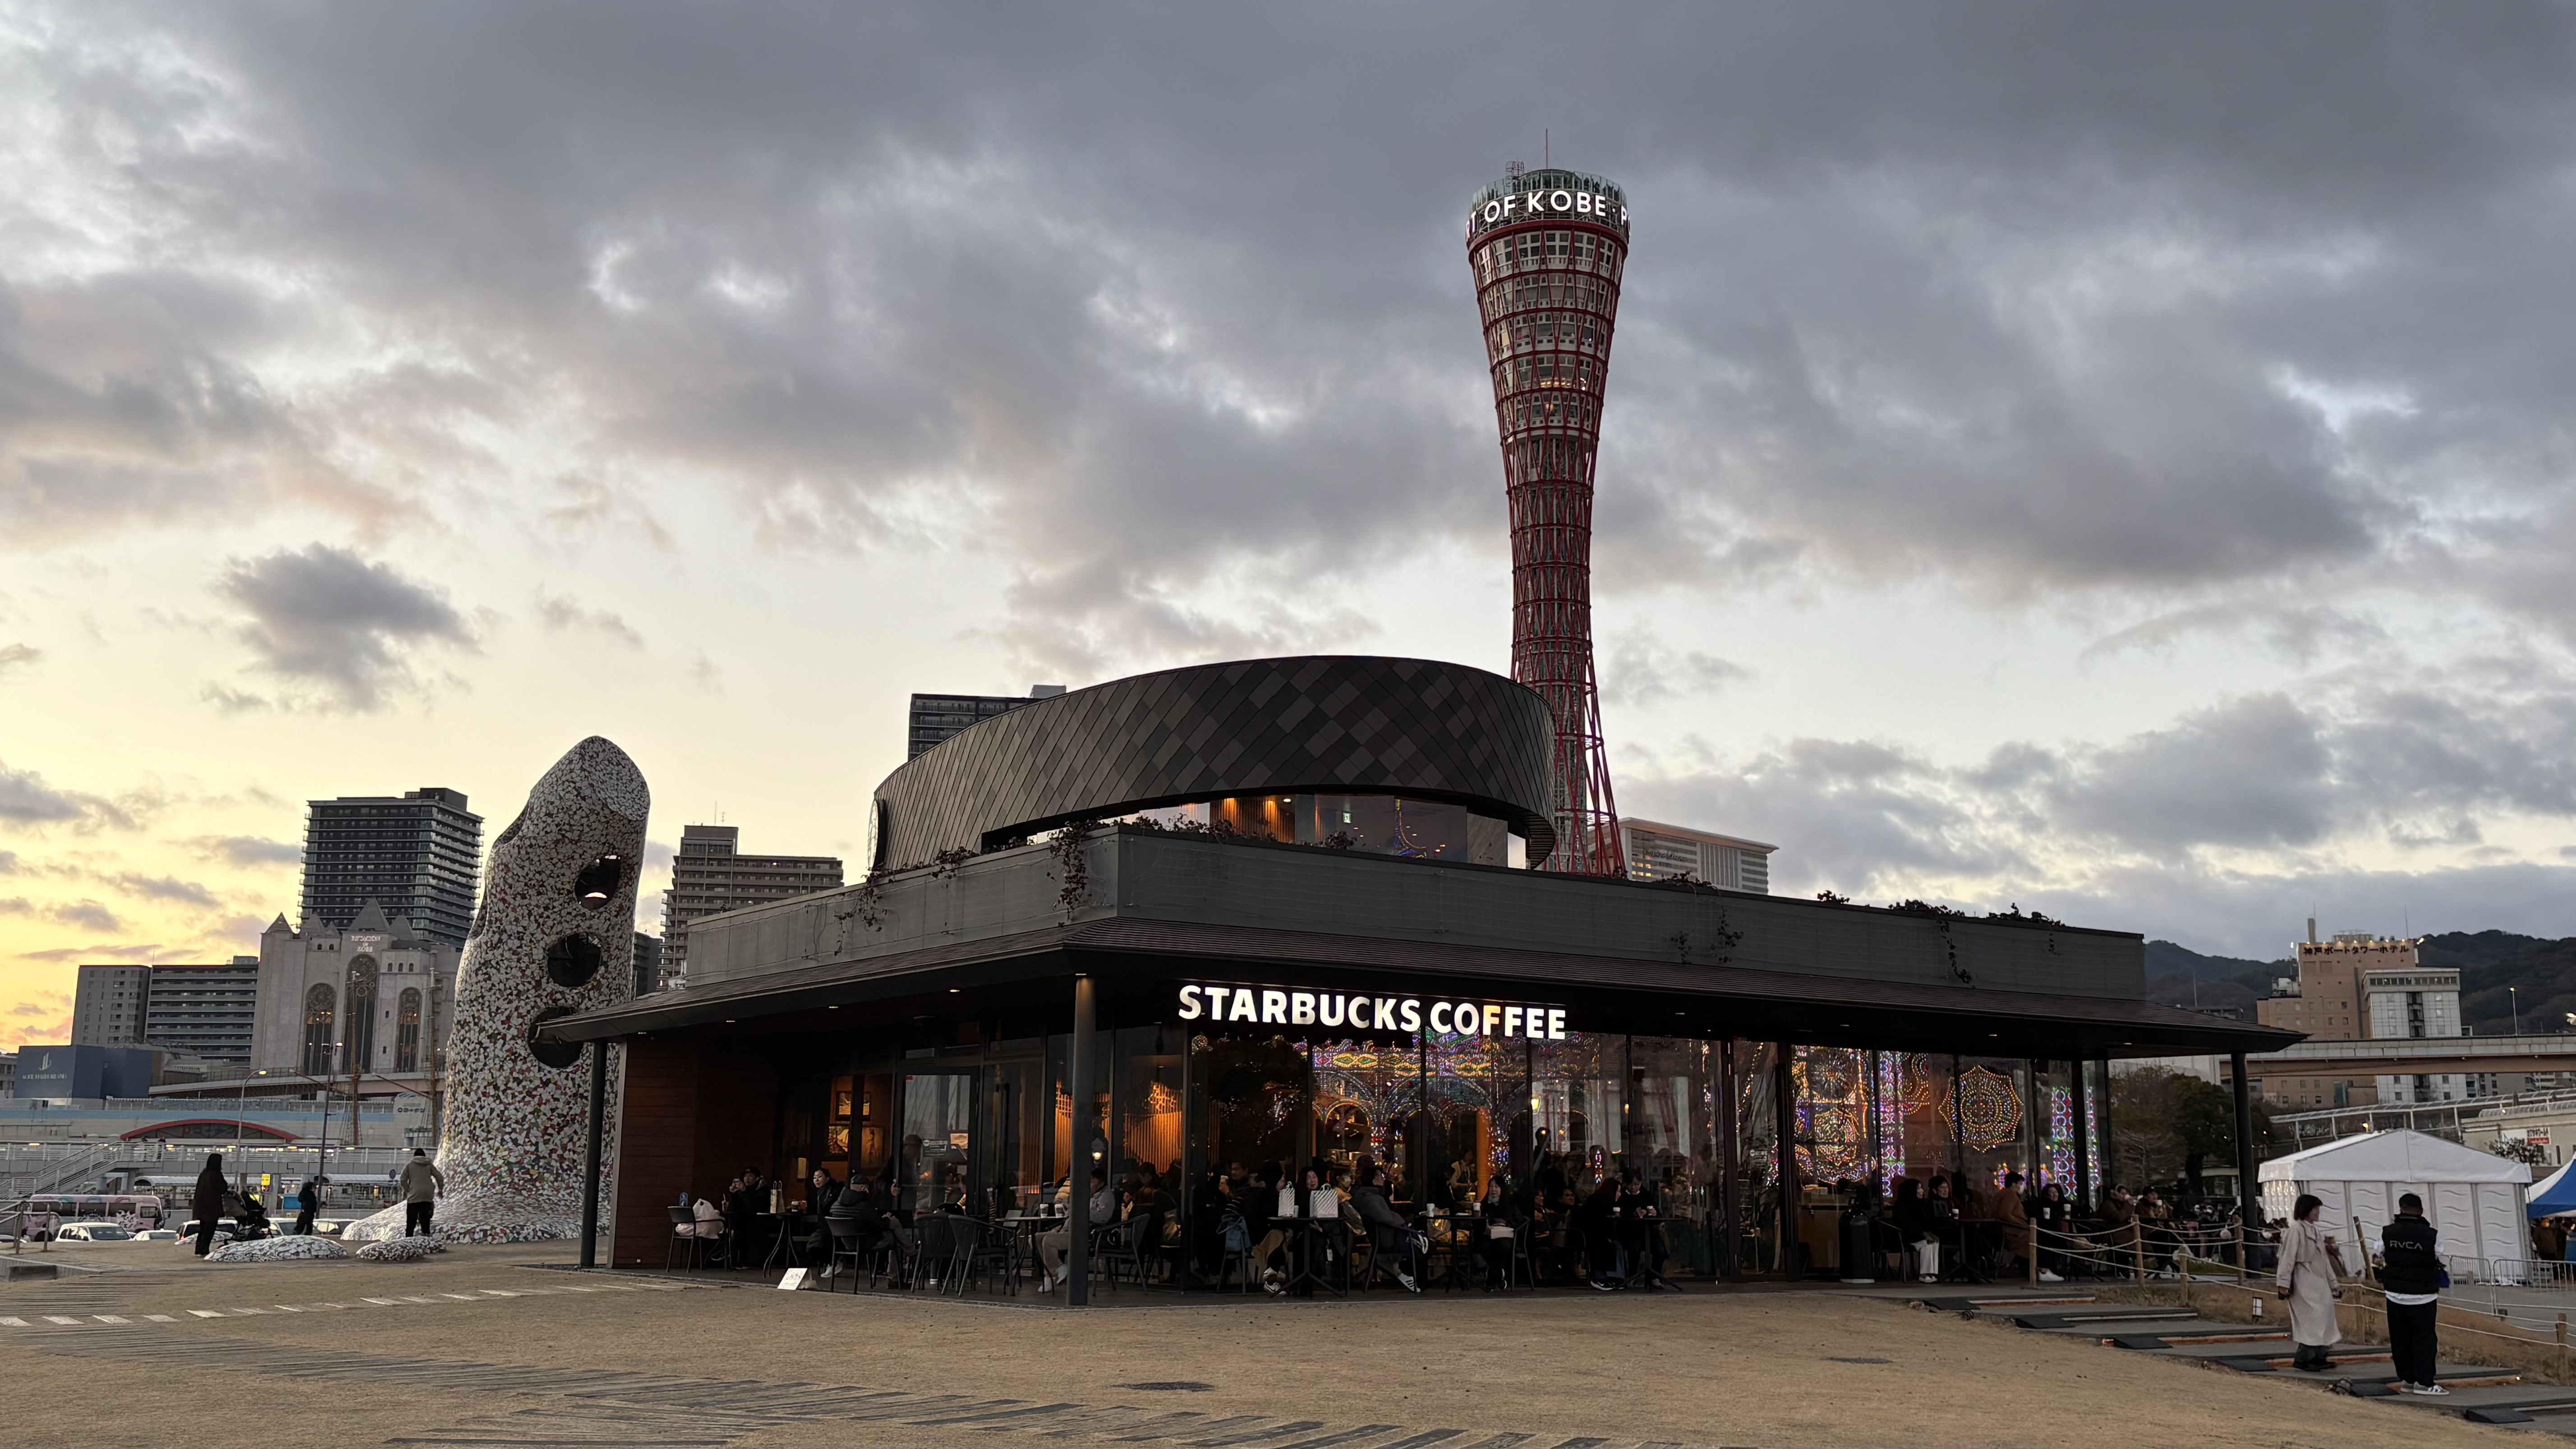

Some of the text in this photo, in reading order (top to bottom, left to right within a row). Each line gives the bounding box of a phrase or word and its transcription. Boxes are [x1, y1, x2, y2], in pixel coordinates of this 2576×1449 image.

[1484, 195, 1516, 222] OF
[1528, 190, 1605, 216] KOBE
[2303, 946, 2409, 956] 神戸ポートタワーホテル
[1178, 985, 1566, 1040] STARBUCKS COFFEE
[2390, 1240, 2423, 1251] RVCA
